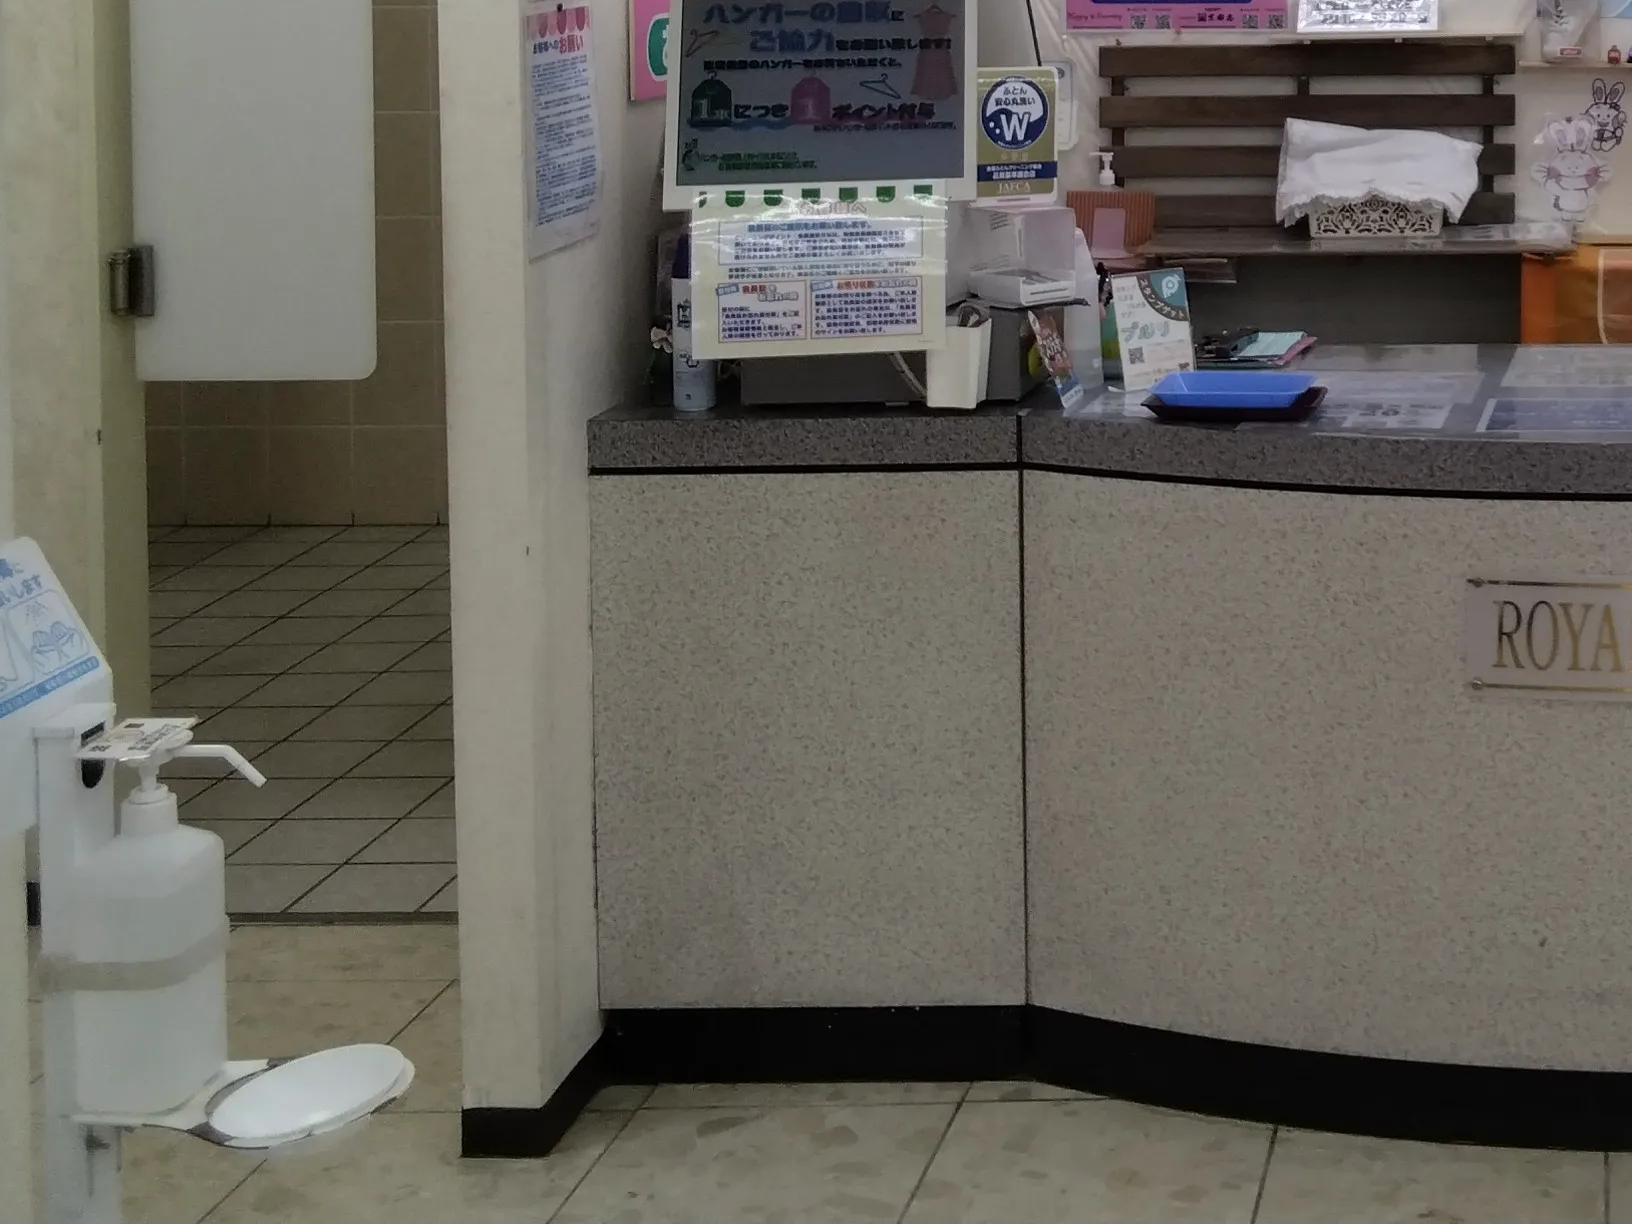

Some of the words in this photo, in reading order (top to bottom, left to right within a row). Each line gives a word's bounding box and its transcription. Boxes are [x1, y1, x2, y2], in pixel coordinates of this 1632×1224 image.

[1003, 86, 1028, 95] ふとん
[1000, 113, 1031, 141] W
